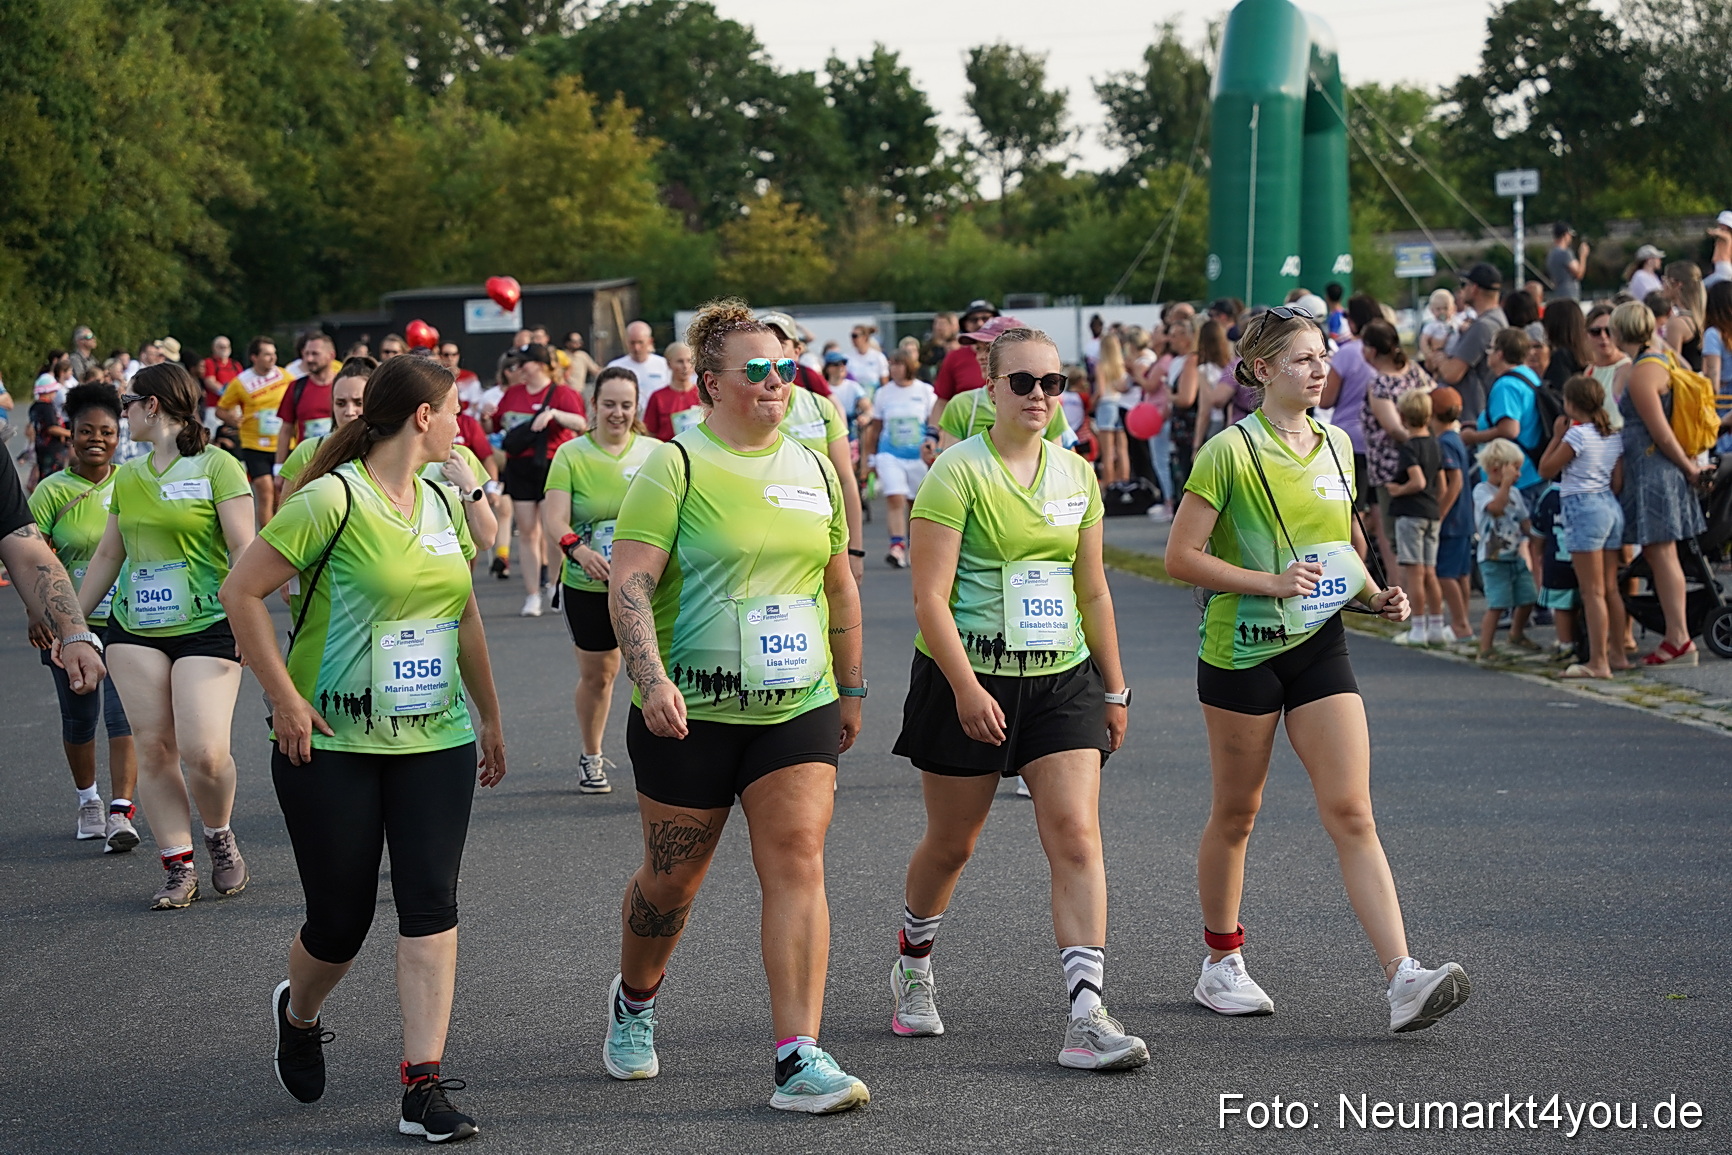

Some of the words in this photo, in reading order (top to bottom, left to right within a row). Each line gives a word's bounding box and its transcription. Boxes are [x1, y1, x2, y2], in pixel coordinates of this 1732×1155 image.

[136, 588, 172, 603] 1340
[1303, 577, 1347, 599] 335
[1022, 599, 1064, 616] 1365
[1301, 603, 1319, 611] Nina
[1020, 621, 1052, 629] Elisabeth
[760, 633, 808, 654] 1343
[393, 658, 441, 680] 1356
[766, 658, 783, 666] Lisa
[784, 657, 808, 666] Hupfer
[385, 684, 414, 693] Marina
[415, 681, 448, 691] Metterlein
